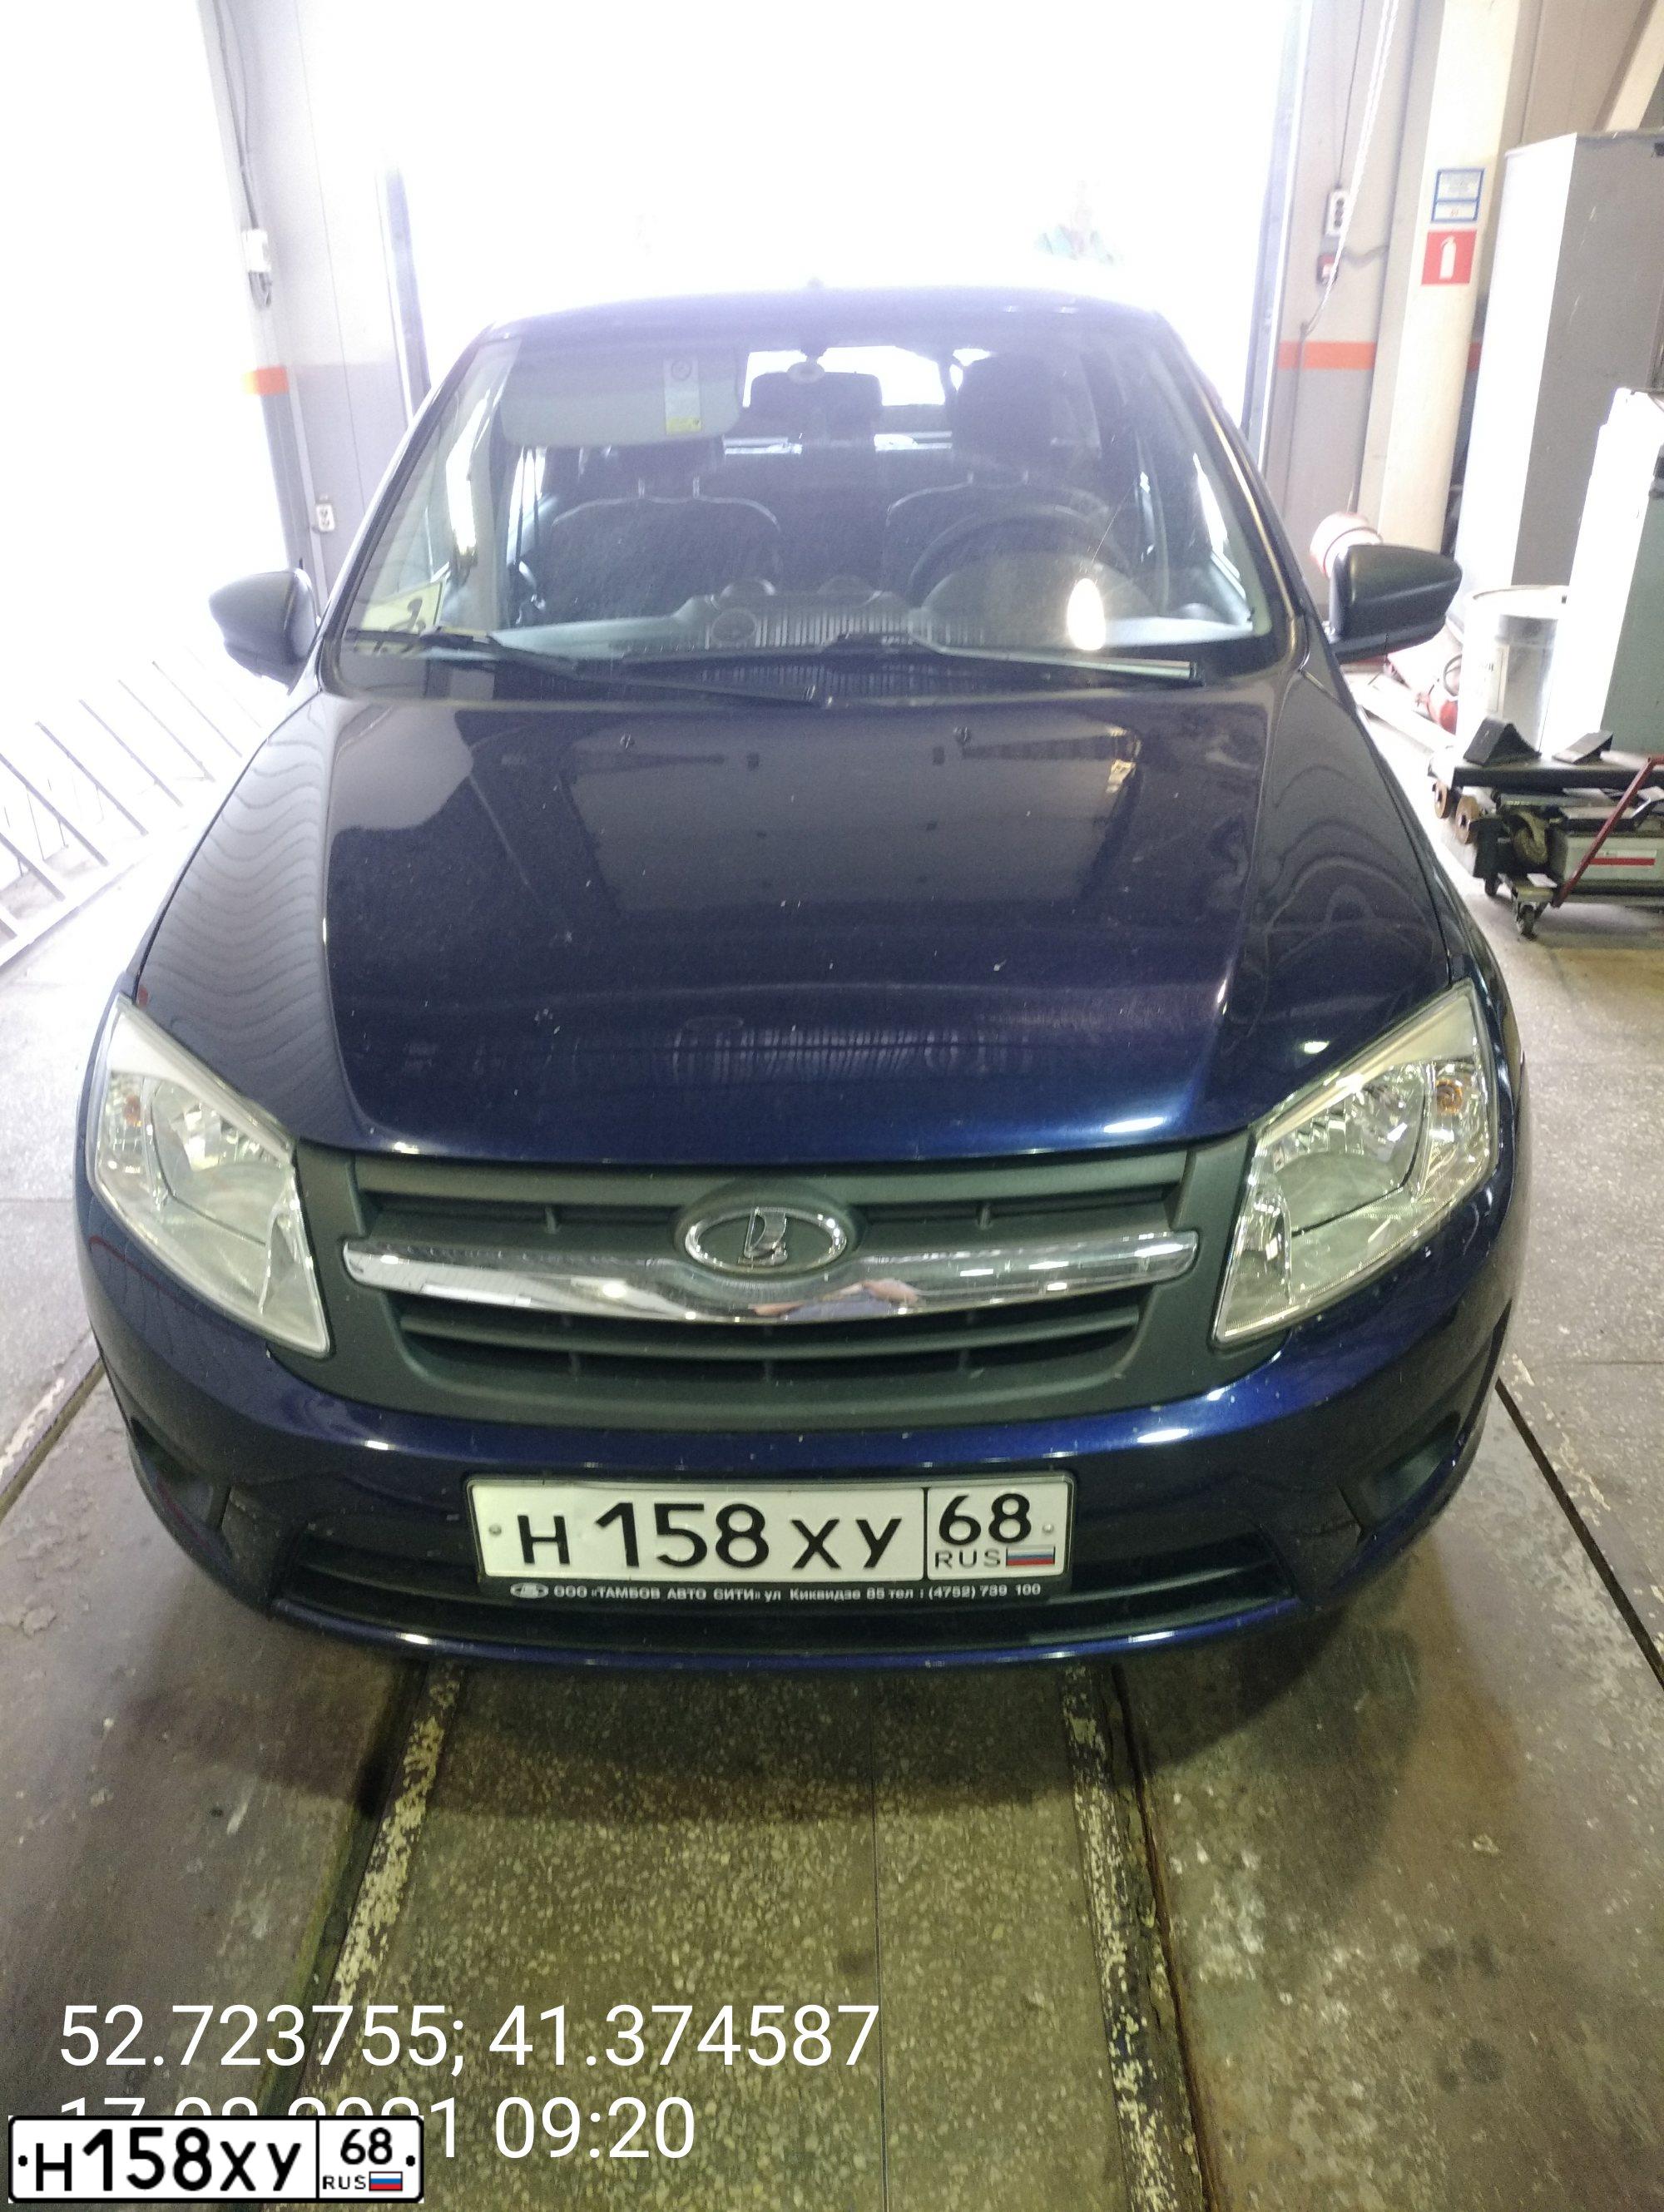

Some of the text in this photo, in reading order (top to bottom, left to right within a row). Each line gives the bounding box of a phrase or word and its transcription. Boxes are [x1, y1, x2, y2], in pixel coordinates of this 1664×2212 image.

[938, 1492, 1032, 1546] 68
[934, 1550, 1001, 1569] RUS
[667, 1587, 706, 1600] АВТО
[1016, 1583, 1041, 1596] 100
